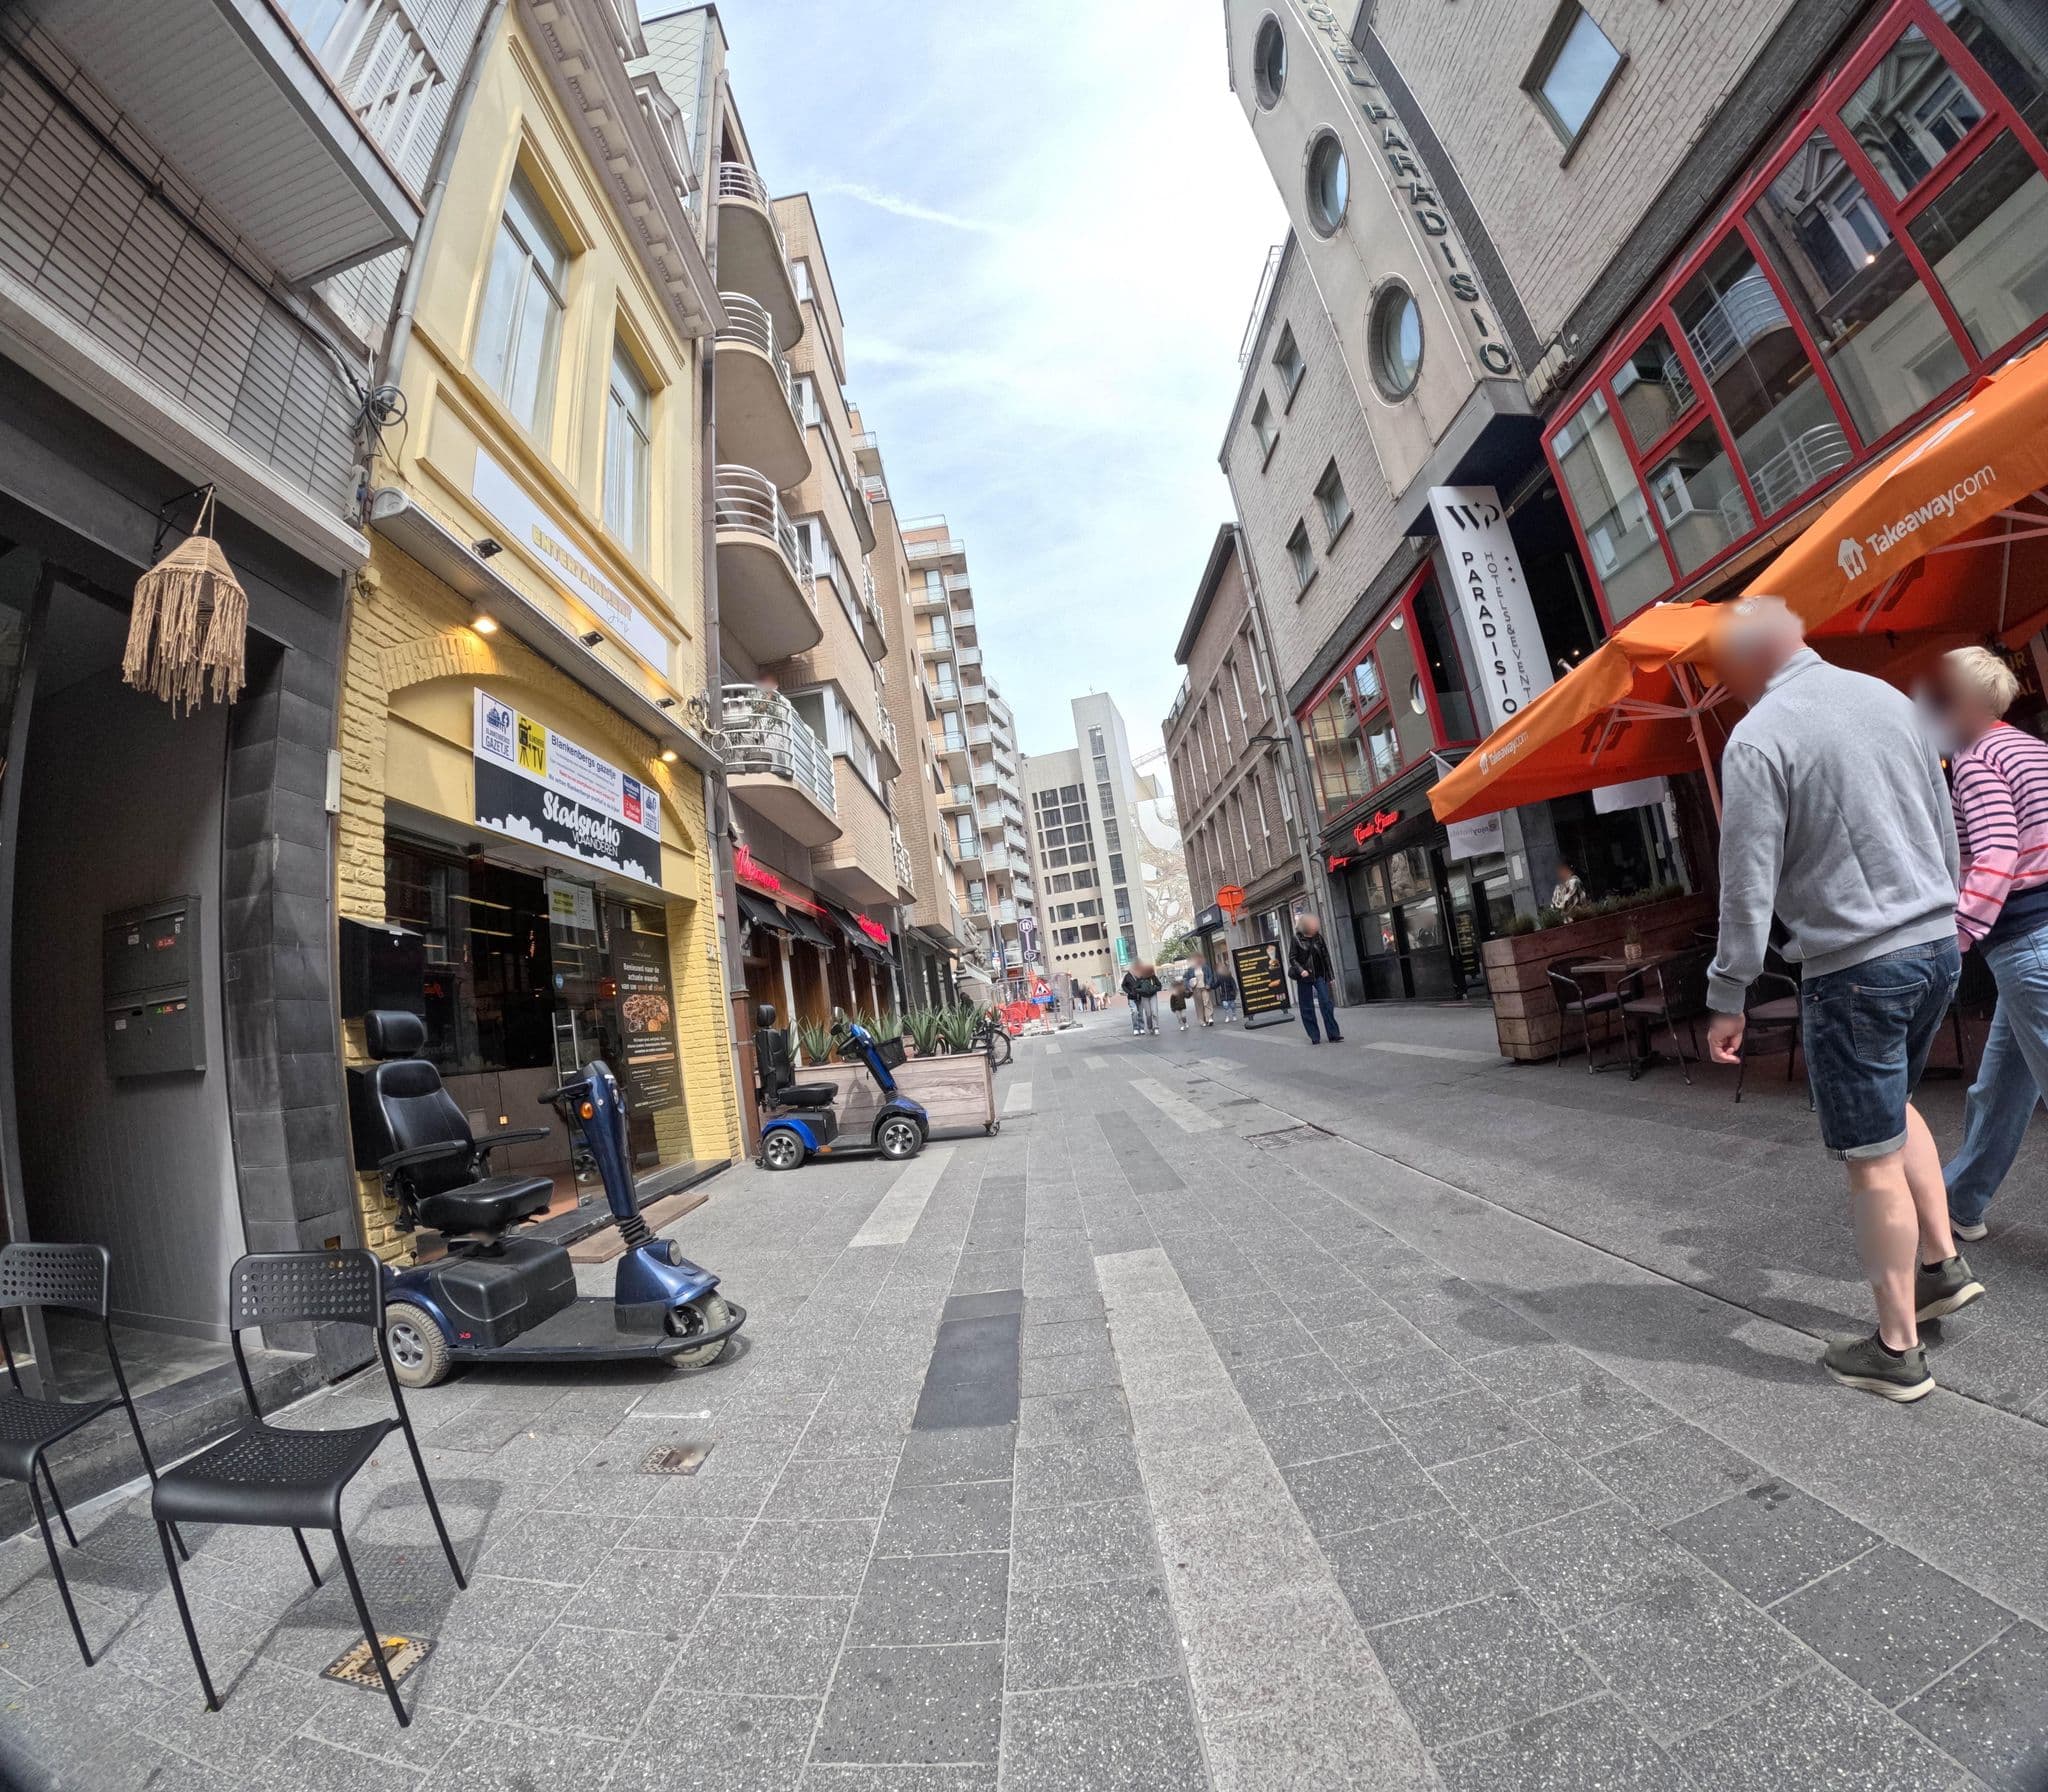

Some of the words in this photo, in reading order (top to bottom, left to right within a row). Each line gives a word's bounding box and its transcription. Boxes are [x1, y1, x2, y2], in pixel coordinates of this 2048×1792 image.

[1300, 0, 1376, 88] OTEL
[1362, 103, 1512, 374] PARADISIO
[1866, 465, 1996, 556] Takeaway.com
[1462, 551, 1518, 714] PARADISIO
[1484, 552, 1534, 704] HOTELS&EVENT
[485, 735, 510, 757] GAZETJE
[532, 744, 544, 770] TV
[551, 734, 595, 768] Blankenbergs
[596, 762, 616, 781] gazetje
[1488, 731, 1529, 766] Takeaway.com
[542, 791, 620, 847] Stadsradio
[572, 829, 618, 857] VLAANDEREN
